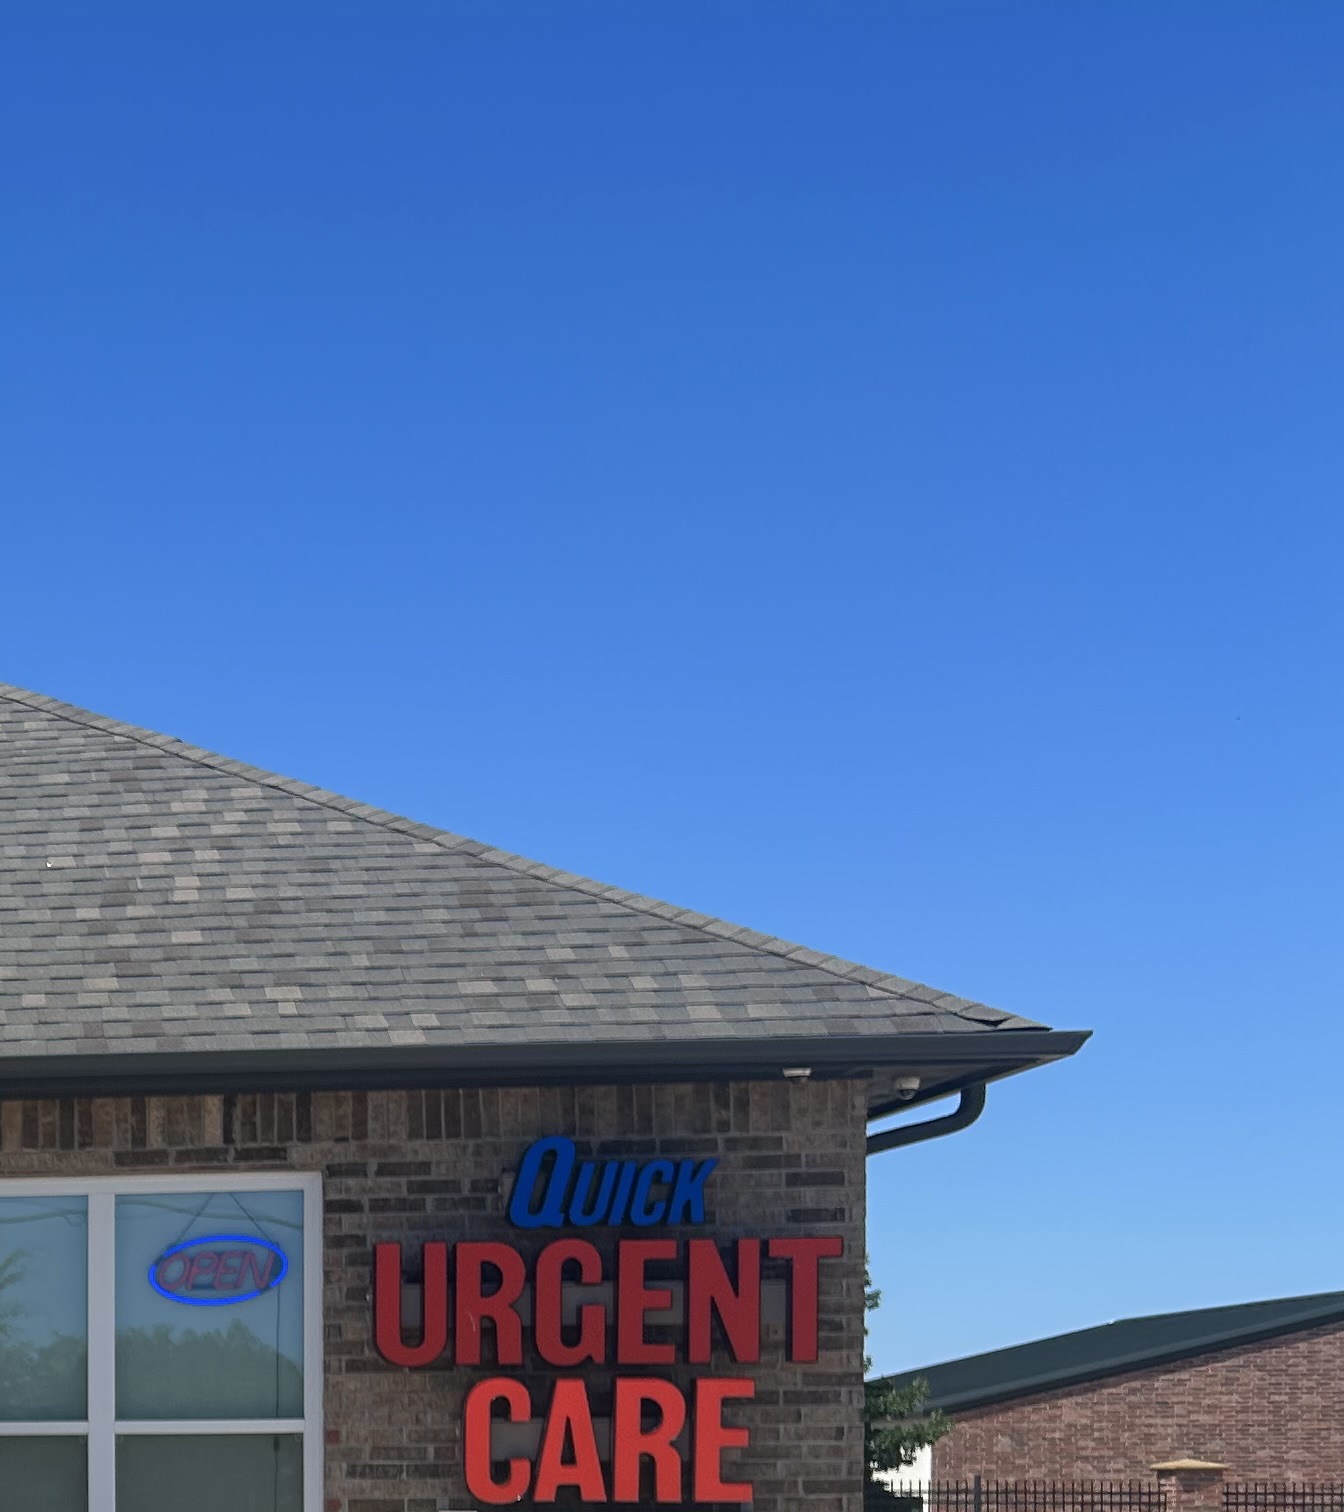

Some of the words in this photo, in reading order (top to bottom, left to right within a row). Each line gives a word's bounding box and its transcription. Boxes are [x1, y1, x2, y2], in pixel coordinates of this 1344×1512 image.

[158, 1249, 276, 1290] OPEN
[373, 1236, 844, 1367] URGENT
[462, 1376, 756, 1504] CARE
